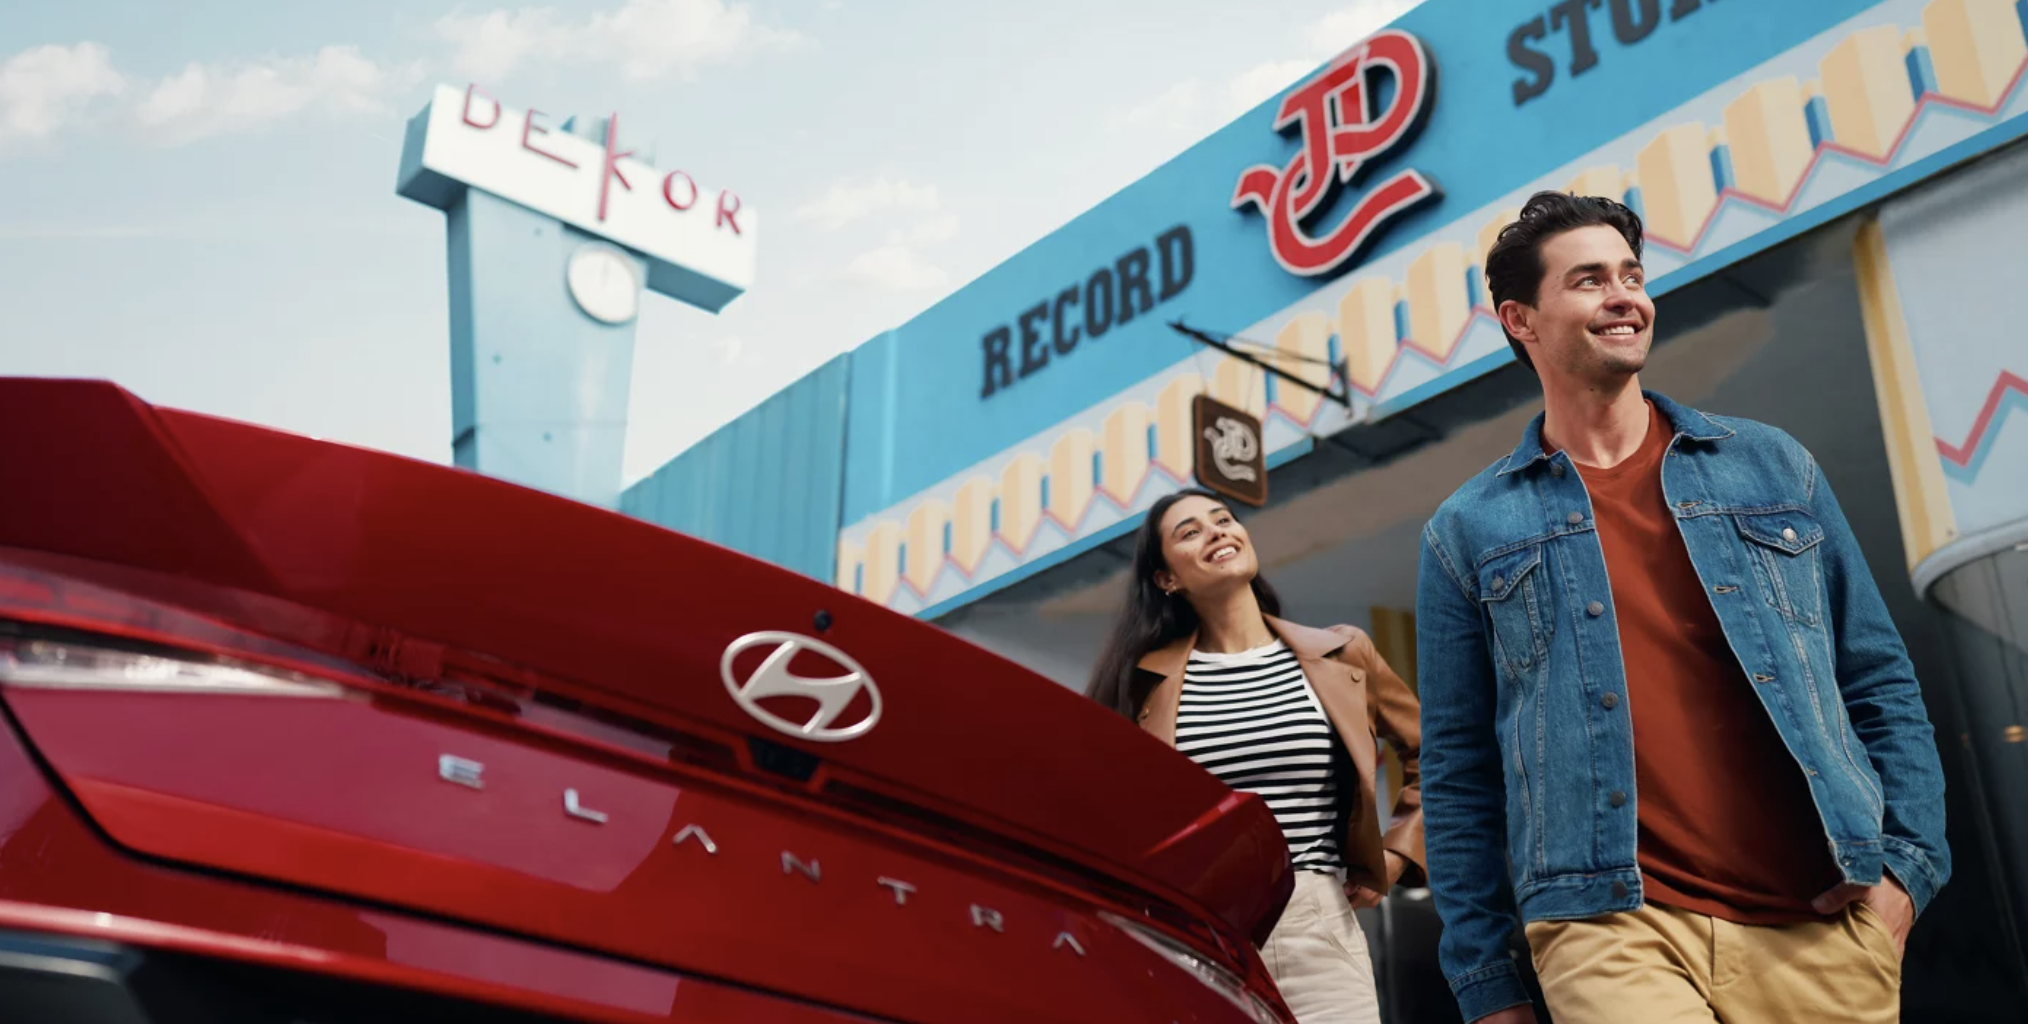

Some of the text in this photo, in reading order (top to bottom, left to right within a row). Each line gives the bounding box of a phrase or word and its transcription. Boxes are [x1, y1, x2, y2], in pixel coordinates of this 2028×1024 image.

[461, 82, 742, 235] DEKOR
[981, 223, 1196, 399] RECORD
[439, 754, 1086, 955] ELANTRA
